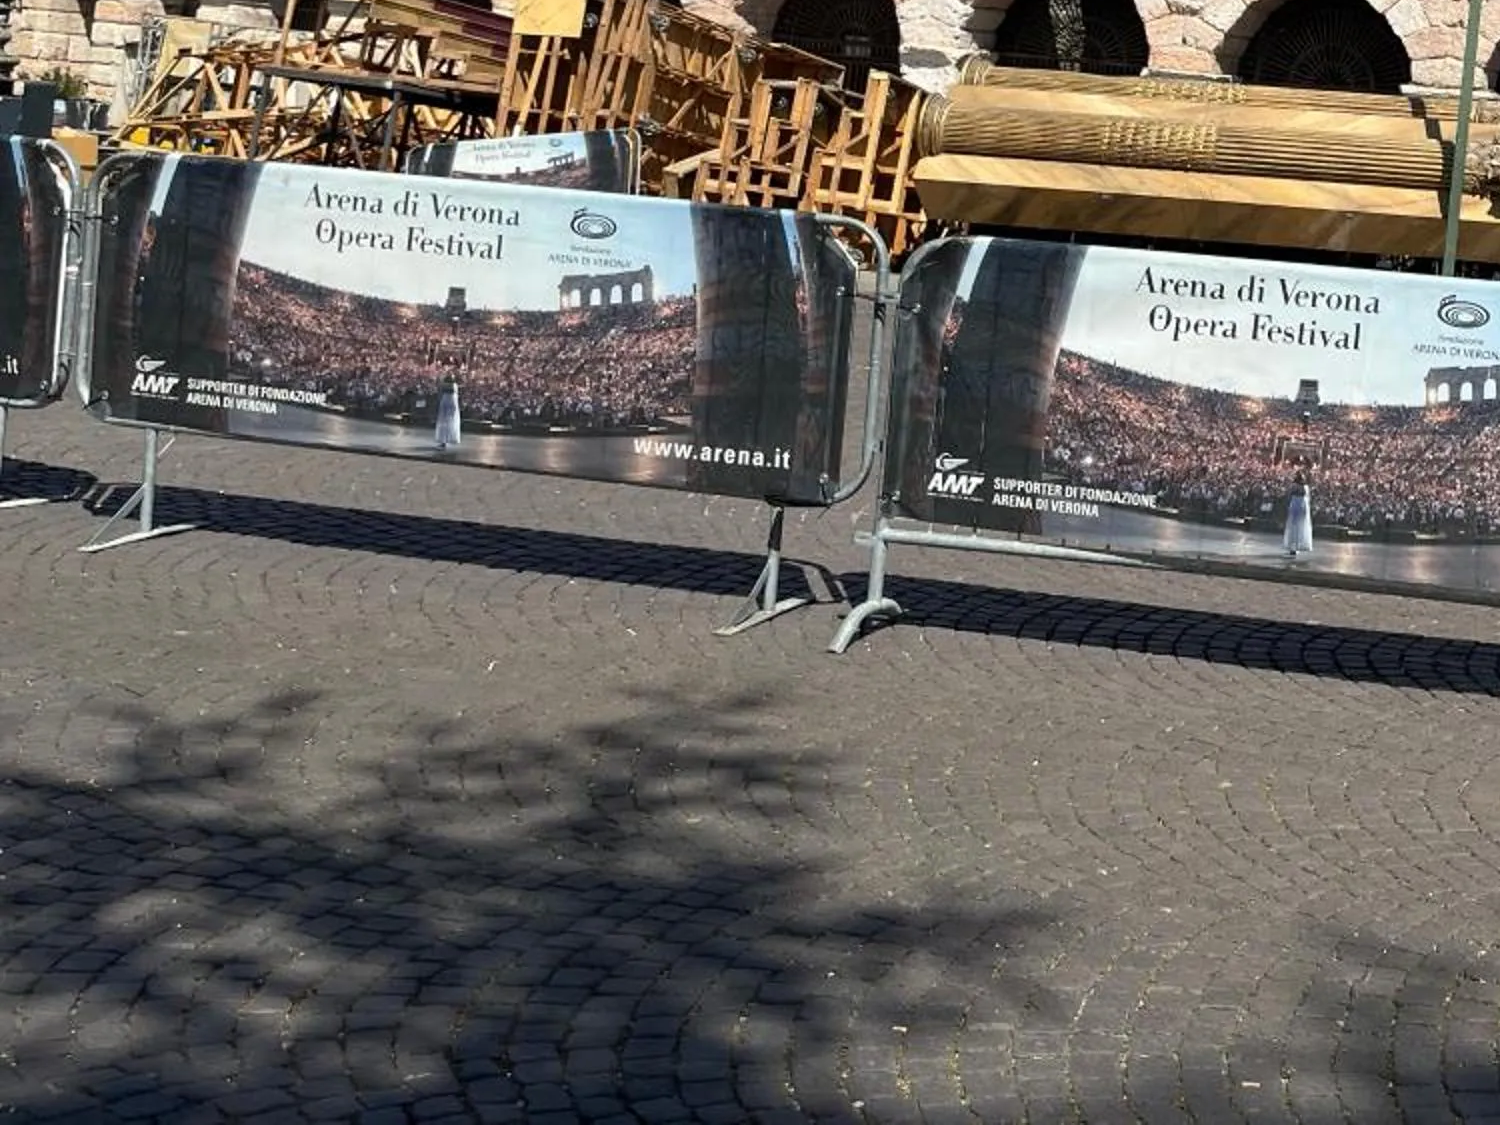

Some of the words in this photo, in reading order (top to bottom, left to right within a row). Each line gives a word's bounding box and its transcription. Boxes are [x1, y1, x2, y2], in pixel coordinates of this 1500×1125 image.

[304, 181, 383, 215] Arena
[393, 191, 419, 217] di
[430, 192, 520, 226] Verona
[315, 218, 394, 253] Opera
[406, 226, 504, 260] Festival
[1135, 266, 1225, 300] Arena
[1236, 274, 1265, 304] di
[1279, 278, 1380, 315] Verona
[1149, 304, 1238, 342] Opera
[1251, 312, 1361, 351] Festival
[131, 373, 180, 394] AMT
[186, 377, 247, 396] SUPPORTER
[248, 385, 259, 397] DI
[260, 386, 327, 405] FONDAZIONE
[186, 392, 221, 408] ARENA
[223, 396, 234, 409] DI
[235, 398, 277, 415] VERONA
[633, 437, 791, 470] www.arena.it
[927, 472, 985, 495] AMT
[993, 476, 1062, 496] SUPPORTER
[1065, 485, 1078, 498] DI
[1080, 487, 1157, 509] FONDAZIONE
[992, 492, 1033, 511] ARENA
[1035, 497, 1049, 511] DI
[1050, 499, 1099, 518] VERONA
